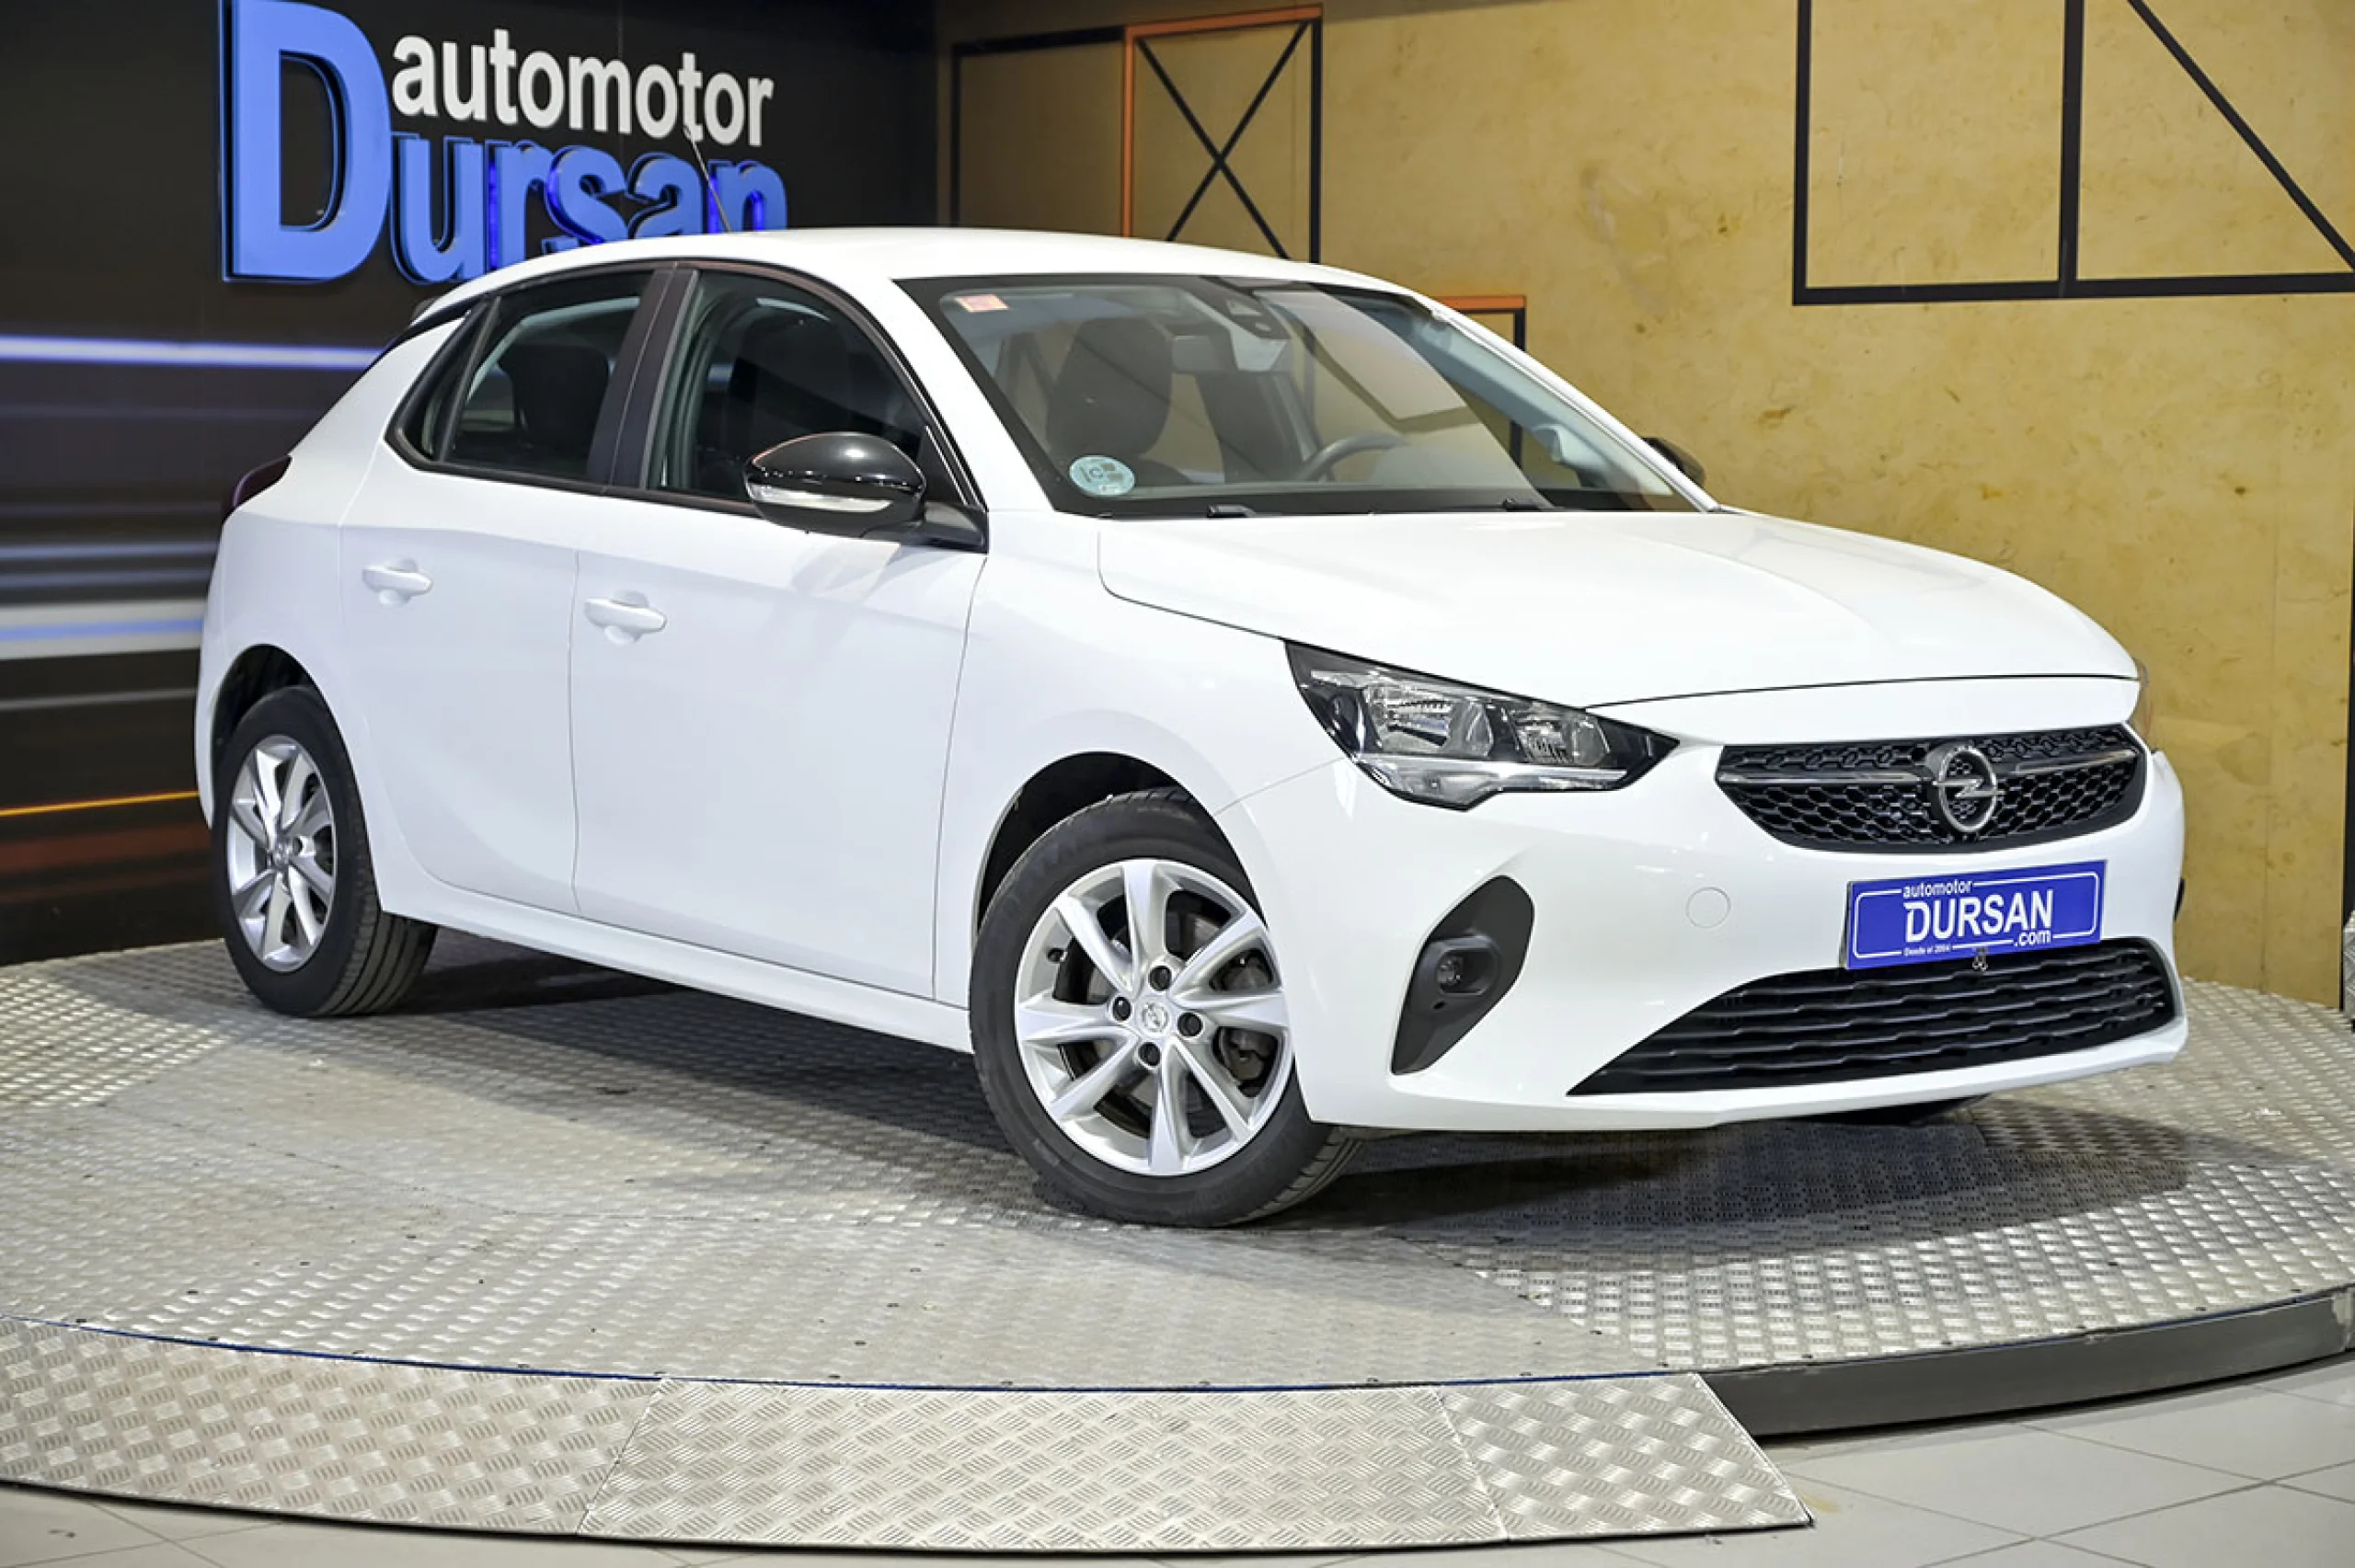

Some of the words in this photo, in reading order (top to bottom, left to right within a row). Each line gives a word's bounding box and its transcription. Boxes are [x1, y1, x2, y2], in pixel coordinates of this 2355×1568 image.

[393, 29, 773, 146] automotor
[1902, 878, 1972, 898] automotor
[1903, 889, 2053, 943] DURSAN
[2014, 930, 2051, 947] .com
